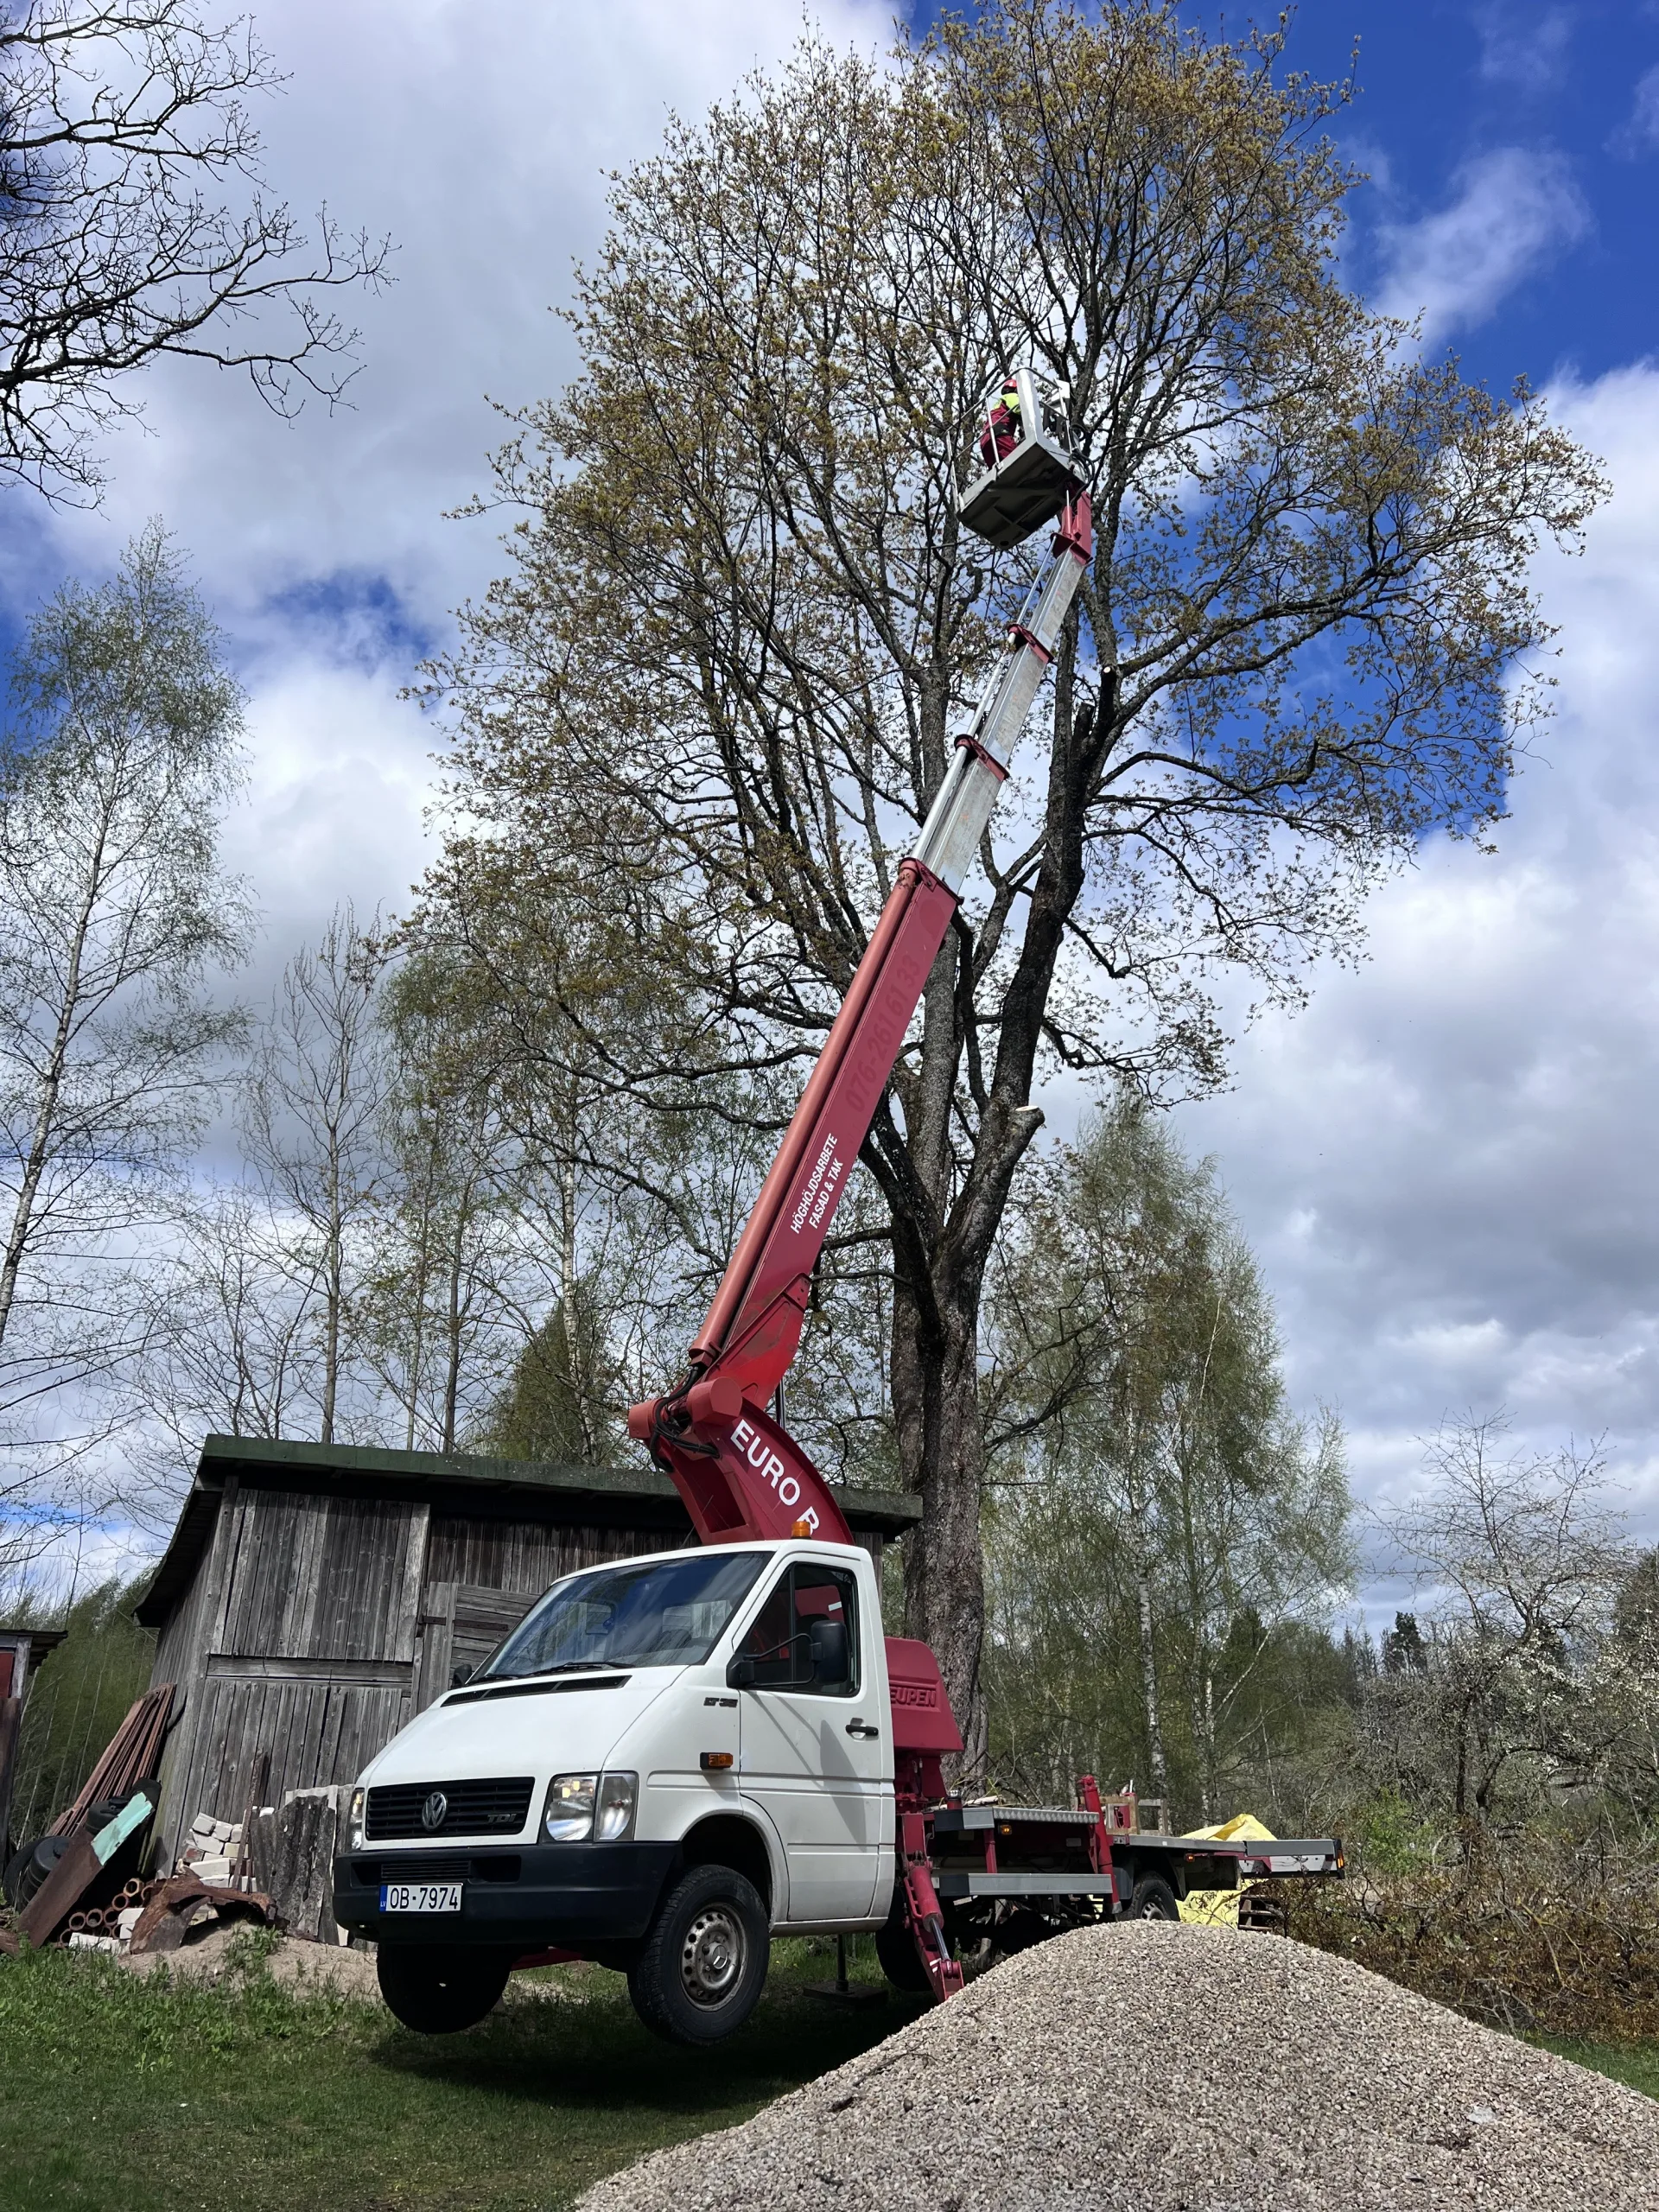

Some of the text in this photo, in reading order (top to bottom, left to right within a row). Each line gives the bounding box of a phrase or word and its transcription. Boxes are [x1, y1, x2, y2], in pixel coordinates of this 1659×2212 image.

[790, 1133, 838, 1234] HÖGHÖJDSARBETE
[808, 1158, 843, 1229] FASAD & TAK
[730, 1419, 801, 1506] EURO
[487, 1813, 518, 1823] TDI
